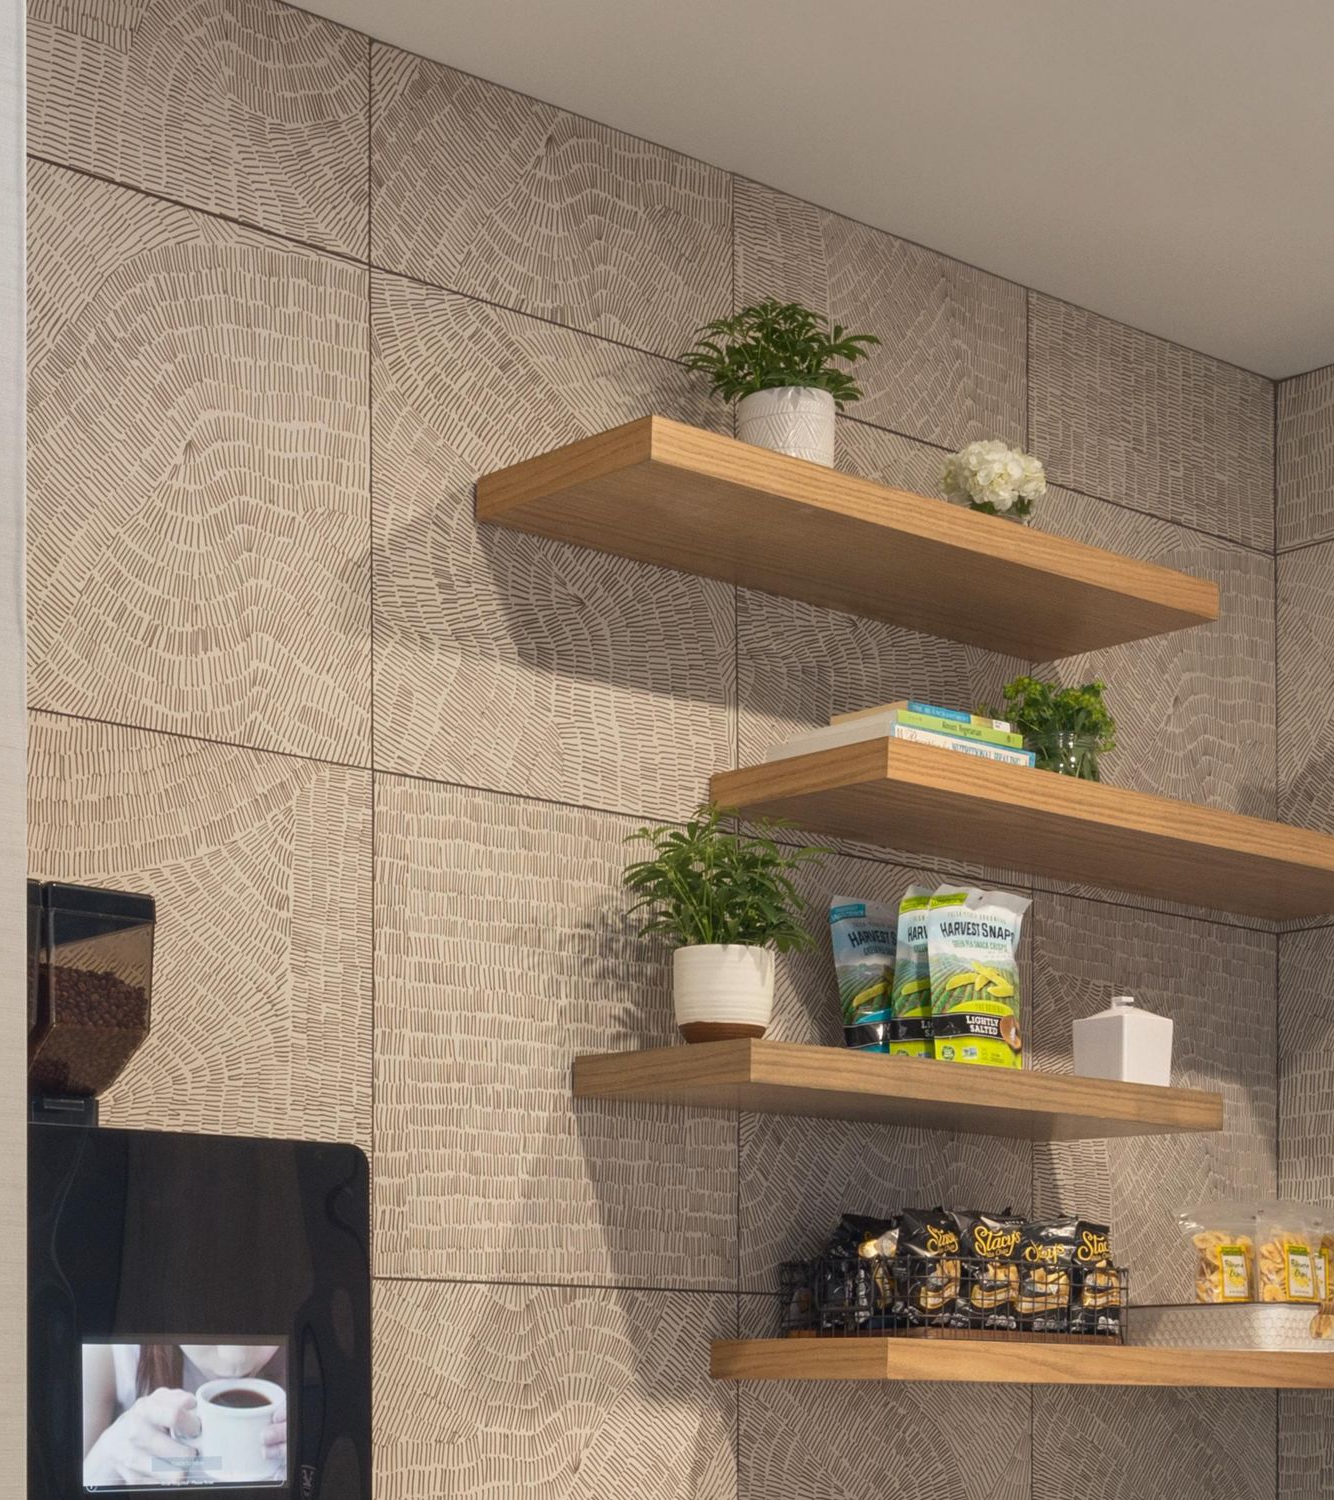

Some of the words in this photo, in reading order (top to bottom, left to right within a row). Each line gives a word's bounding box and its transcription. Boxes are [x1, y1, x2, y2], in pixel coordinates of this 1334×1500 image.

[940, 921, 981, 938] HARVEST
[848, 929, 890, 948] HARVEST
[966, 1015, 999, 1027] LIGHTLY
[970, 1024, 998, 1036] SALTED
[974, 1225, 1021, 1257] Stacy's
